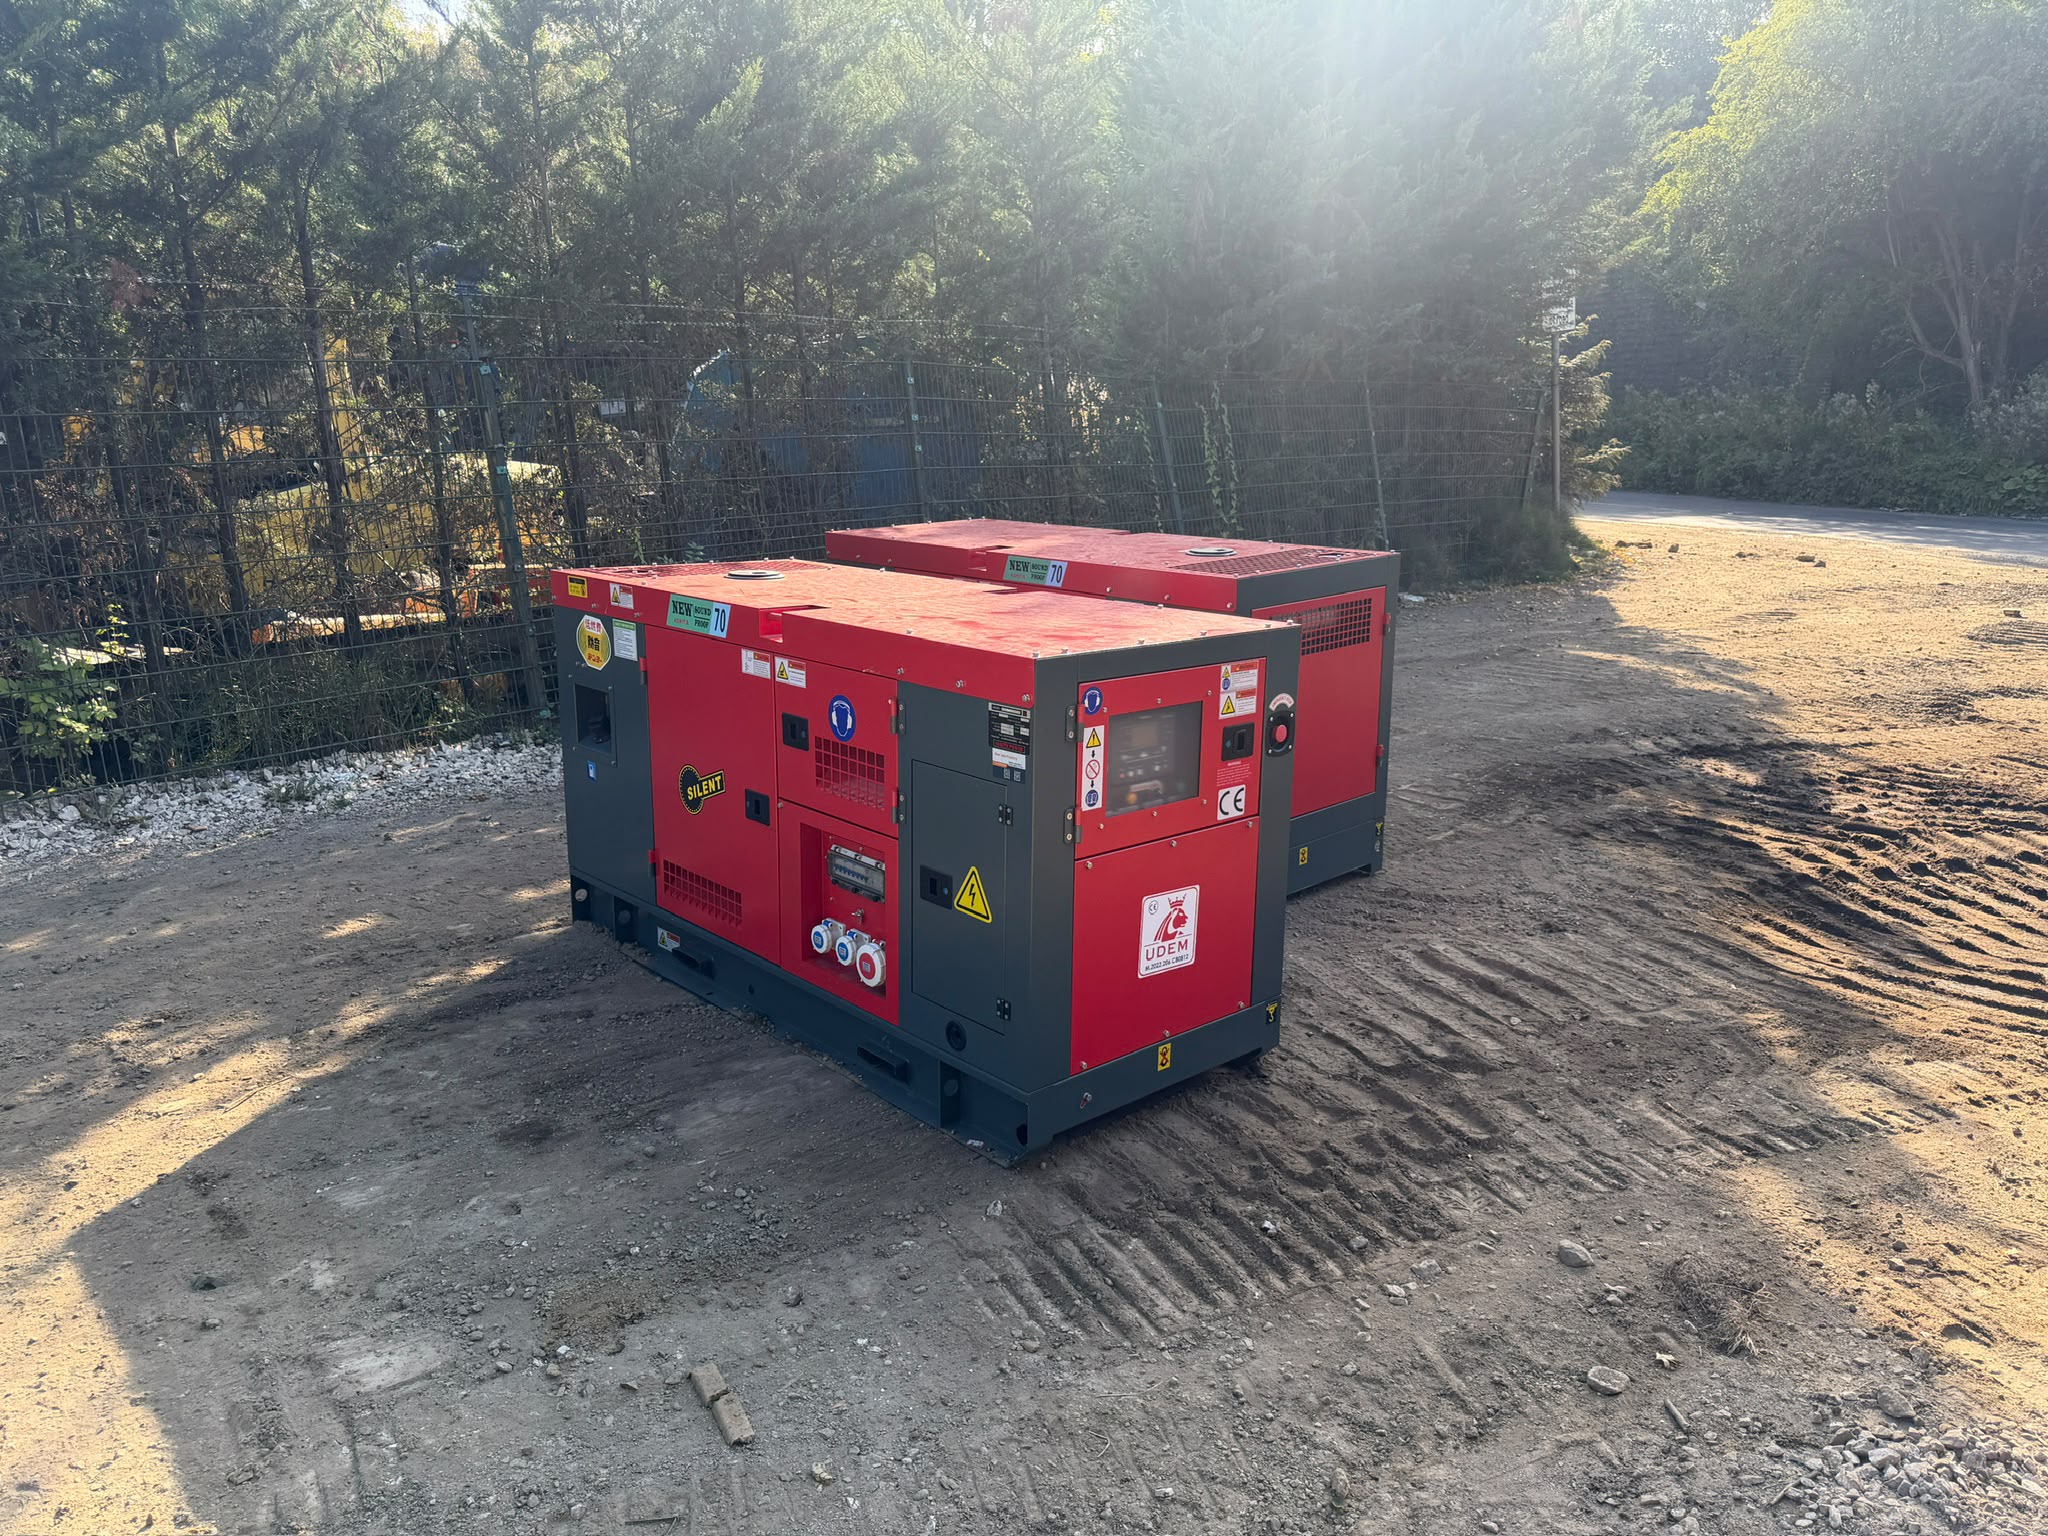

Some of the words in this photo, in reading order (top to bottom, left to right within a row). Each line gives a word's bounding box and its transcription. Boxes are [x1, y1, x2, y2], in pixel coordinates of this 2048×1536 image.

[1009, 560, 1030, 572] NEW
[1051, 565, 1063, 583] 70
[672, 600, 693, 617] NEW
[714, 607, 726, 632] 70
[687, 775, 721, 800] SILENT
[1219, 787, 1245, 815] CE
[1145, 939, 1189, 962] UDEM
